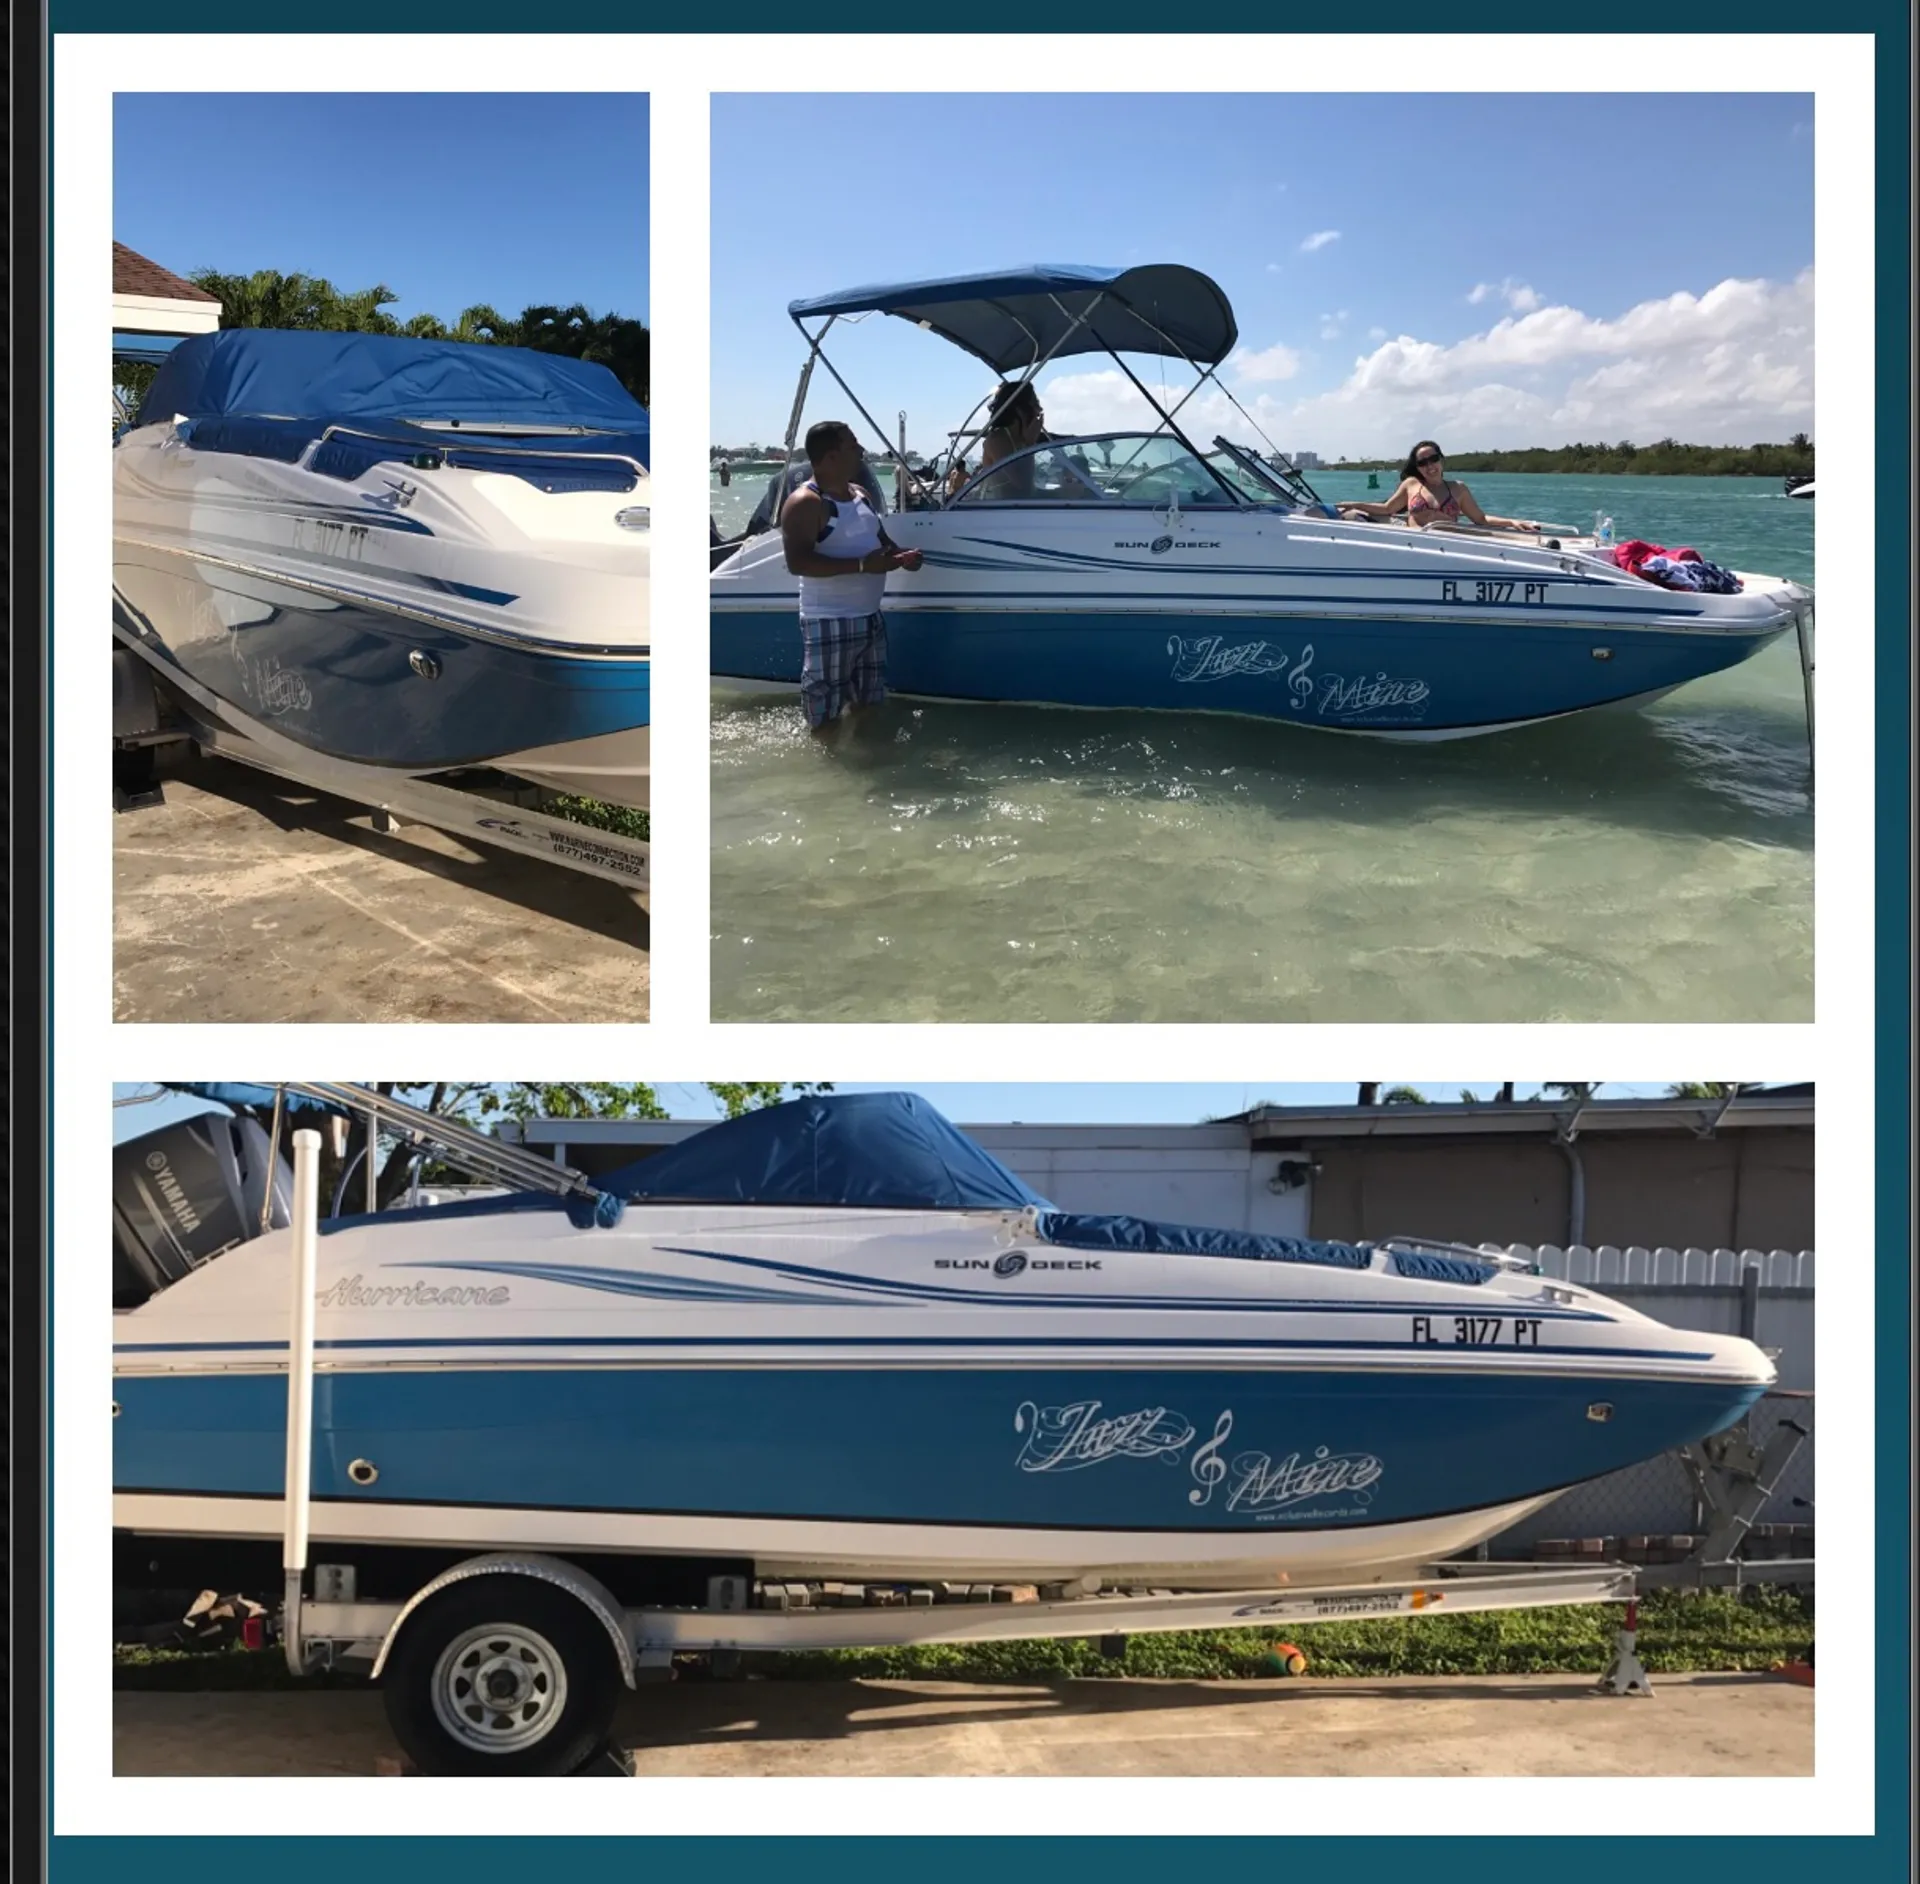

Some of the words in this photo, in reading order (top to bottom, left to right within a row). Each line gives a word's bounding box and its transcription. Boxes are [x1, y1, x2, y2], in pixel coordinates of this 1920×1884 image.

[1114, 541, 1149, 549] SUN
[1174, 541, 1221, 549] DECK
[1443, 580, 1462, 601] FL
[1475, 581, 1515, 603] 3177
[1525, 583, 1549, 604] PT
[1167, 635, 1289, 683] Jazz
[1317, 671, 1431, 716] Mine
[154, 1165, 201, 1235] YAMAHA
[934, 1259, 990, 1270] SUN
[1031, 1260, 1102, 1271] DECK
[315, 1274, 511, 1308] Hurricane
[1412, 1316, 1439, 1342] FL
[1454, 1317, 1503, 1344] 3177
[1515, 1319, 1543, 1346] PT
[1015, 1400, 1197, 1473] Jazz
[1227, 1444, 1385, 1513] Mine
